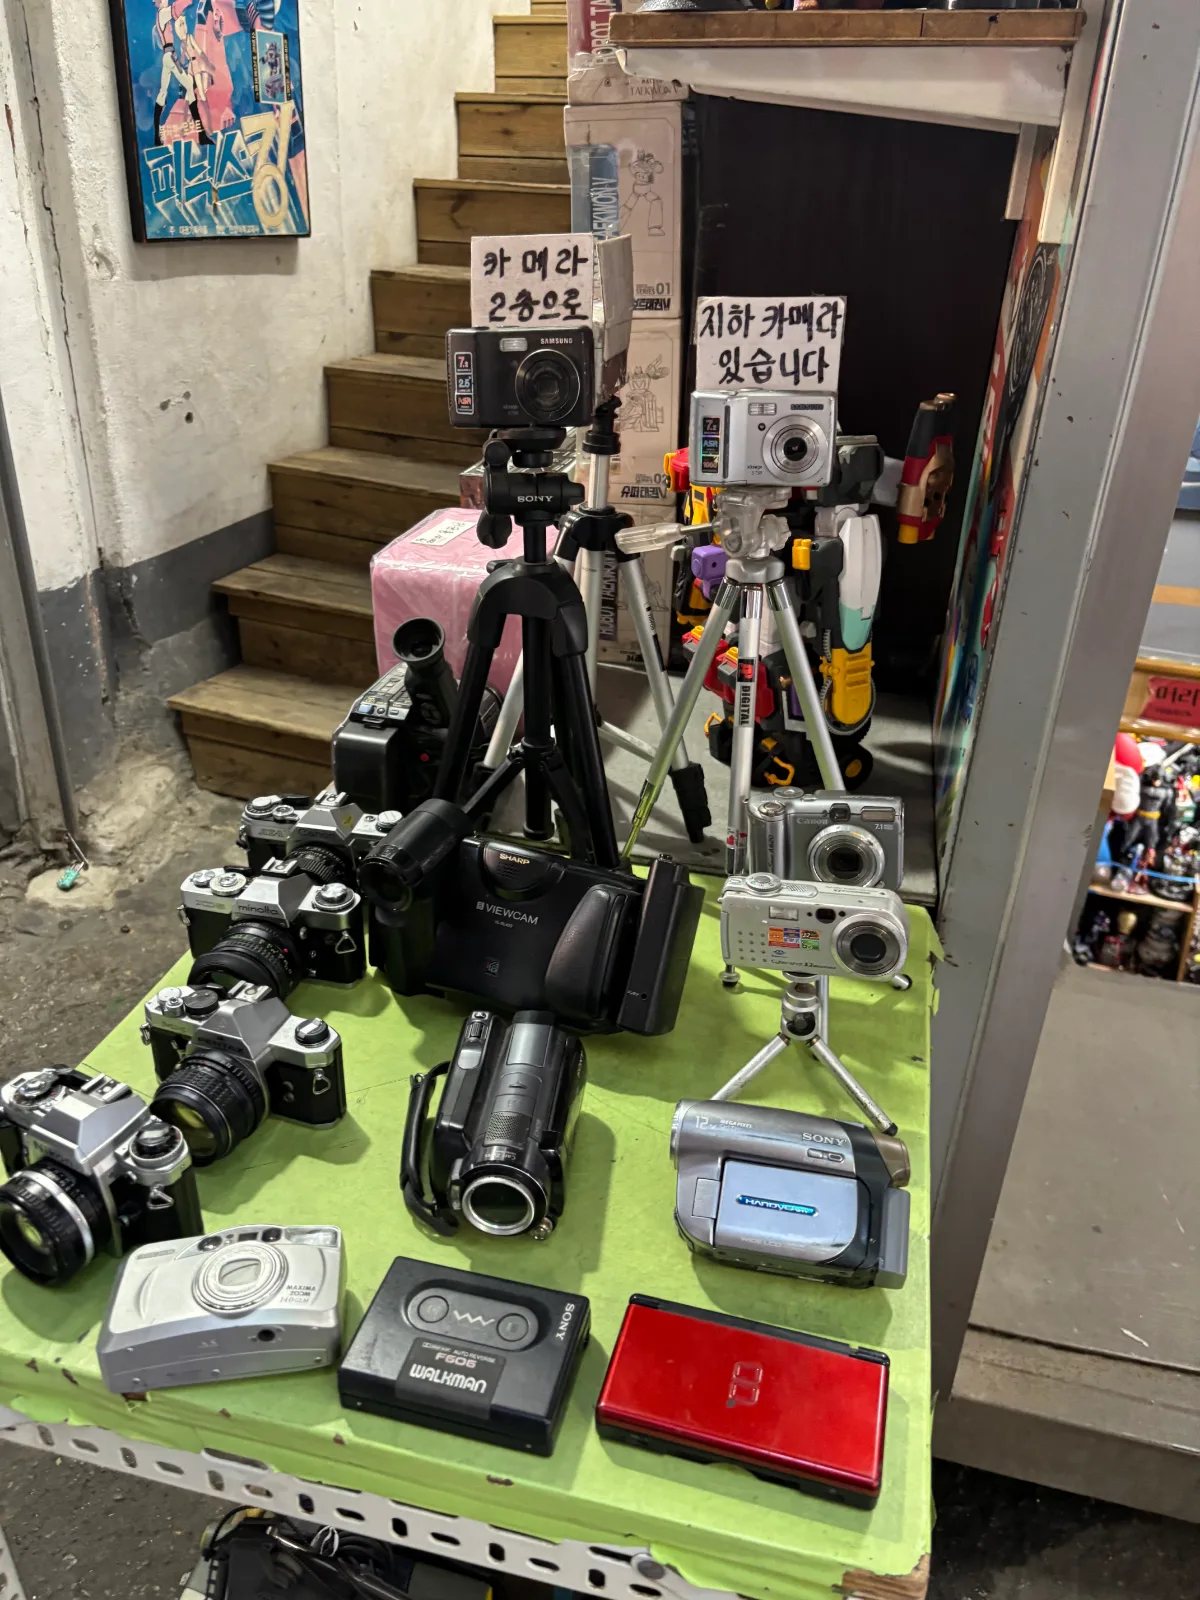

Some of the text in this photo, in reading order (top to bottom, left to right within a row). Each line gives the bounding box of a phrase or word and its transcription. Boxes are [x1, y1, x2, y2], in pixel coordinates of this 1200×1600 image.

[591, 20, 617, 65] ROBOT
[592, 187, 618, 240] AEKWON
[656, 282, 671, 295] 01
[489, 288, 589, 323] 2층으로
[699, 301, 843, 342] 지하 카메라
[540, 337, 573, 345] SAMSUNG
[719, 346, 830, 386] 있습니다
[517, 495, 554, 503] SONY
[740, 685, 751, 726] DIGITAL
[796, 817, 828, 825] Canon
[499, 852, 530, 865] SHARP
[238, 904, 278, 915] minolta
[485, 902, 539, 925] VIEWCAM
[802, 1132, 845, 1147] SONY
[556, 1302, 575, 1341] SONY
[435, 1352, 477, 1369] F606
[453, 1348, 497, 1364] AUTO REVERSE
[408, 1363, 488, 1394] WALKMAN
